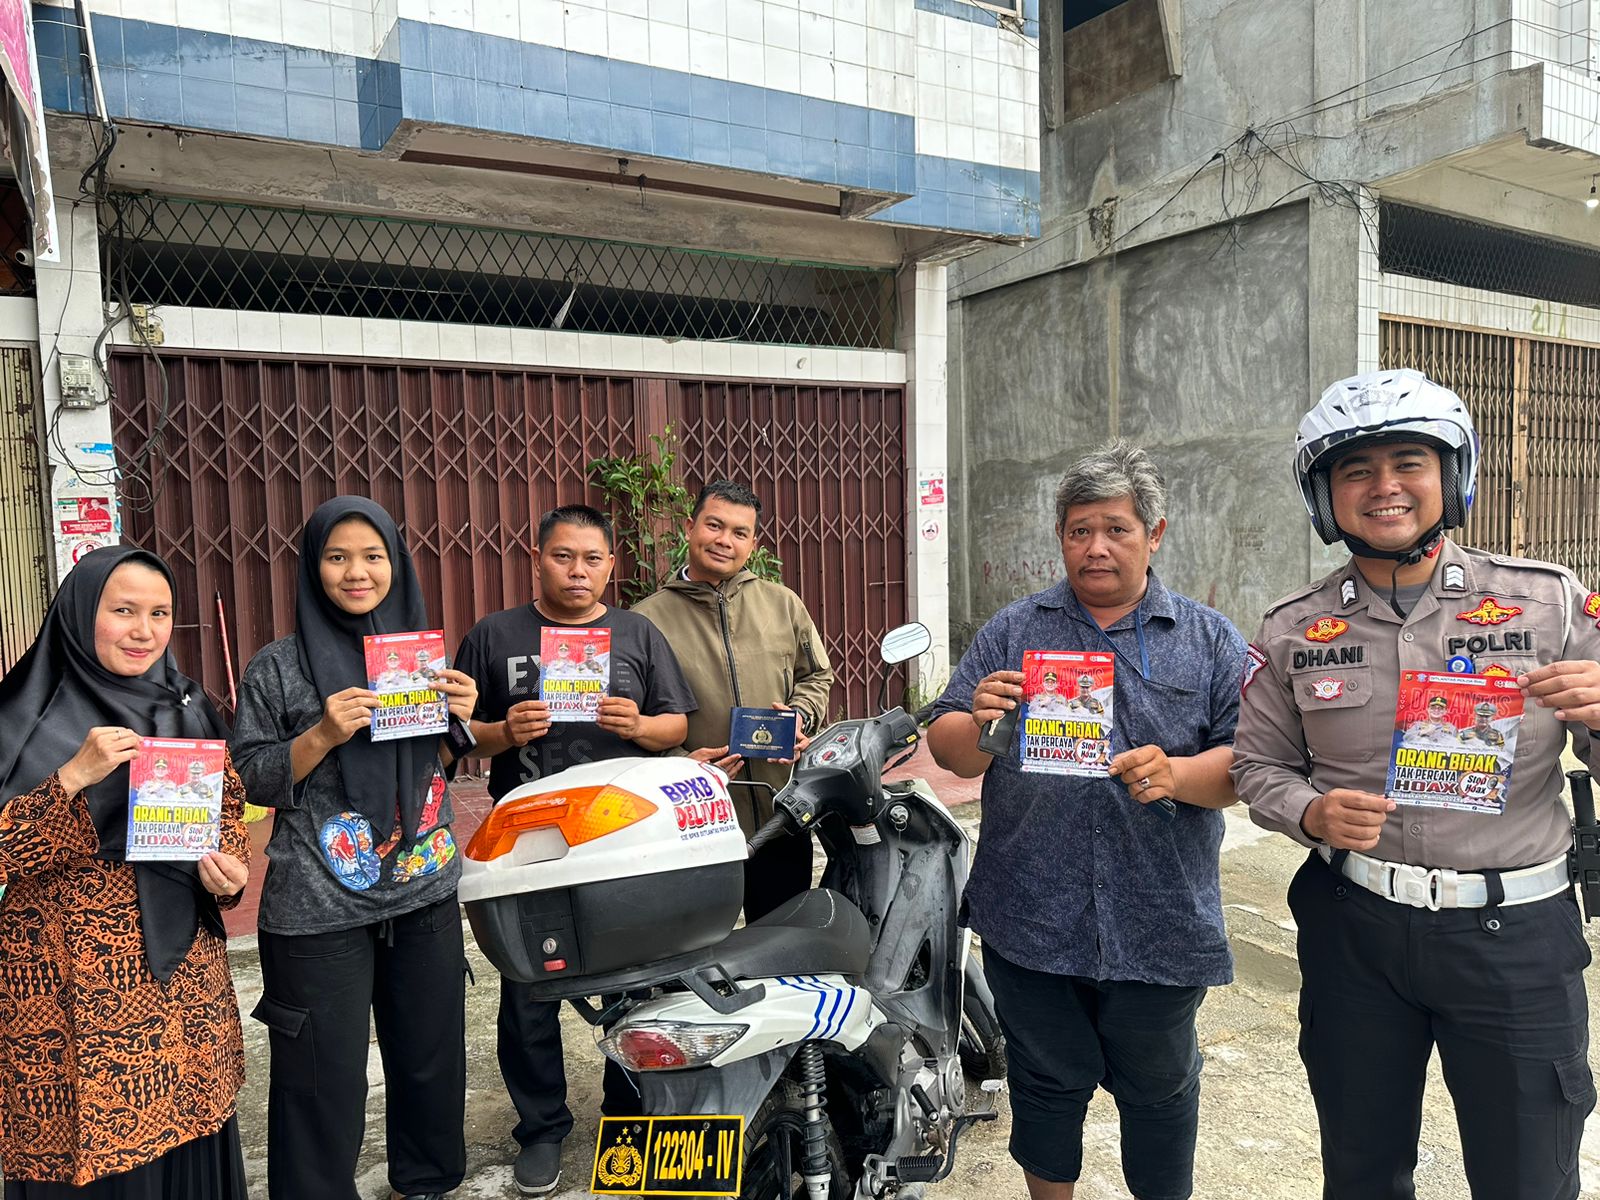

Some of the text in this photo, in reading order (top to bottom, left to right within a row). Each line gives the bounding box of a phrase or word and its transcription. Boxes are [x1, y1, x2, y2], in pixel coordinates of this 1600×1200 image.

[1448, 630, 1532, 655] POLRI
[1293, 646, 1364, 669] DHANI
[543, 679, 601, 693] ORANG BIJAK
[379, 690, 438, 708] RANG BIJAK
[376, 705, 415, 717] TAK PERCAYA
[377, 716, 417, 728] HOAX
[1025, 718, 1102, 739] ORANG BIJAK
[1026, 735, 1073, 748] TAK PERCAYA
[1026, 747, 1074, 760] HOAX
[1395, 748, 1497, 773] ORANG BIJAK
[1396, 766, 1457, 782] TAK PERCAYA
[1467, 775, 1487, 785] Stop
[659, 776, 714, 804] BPKB
[1394, 779, 1458, 794] HOAX
[1465, 784, 1487, 795] Hoax
[133, 805, 209, 823] ORANG BIJAK
[134, 823, 180, 834] TAK PERCAYA
[134, 835, 182, 846] HOAX
